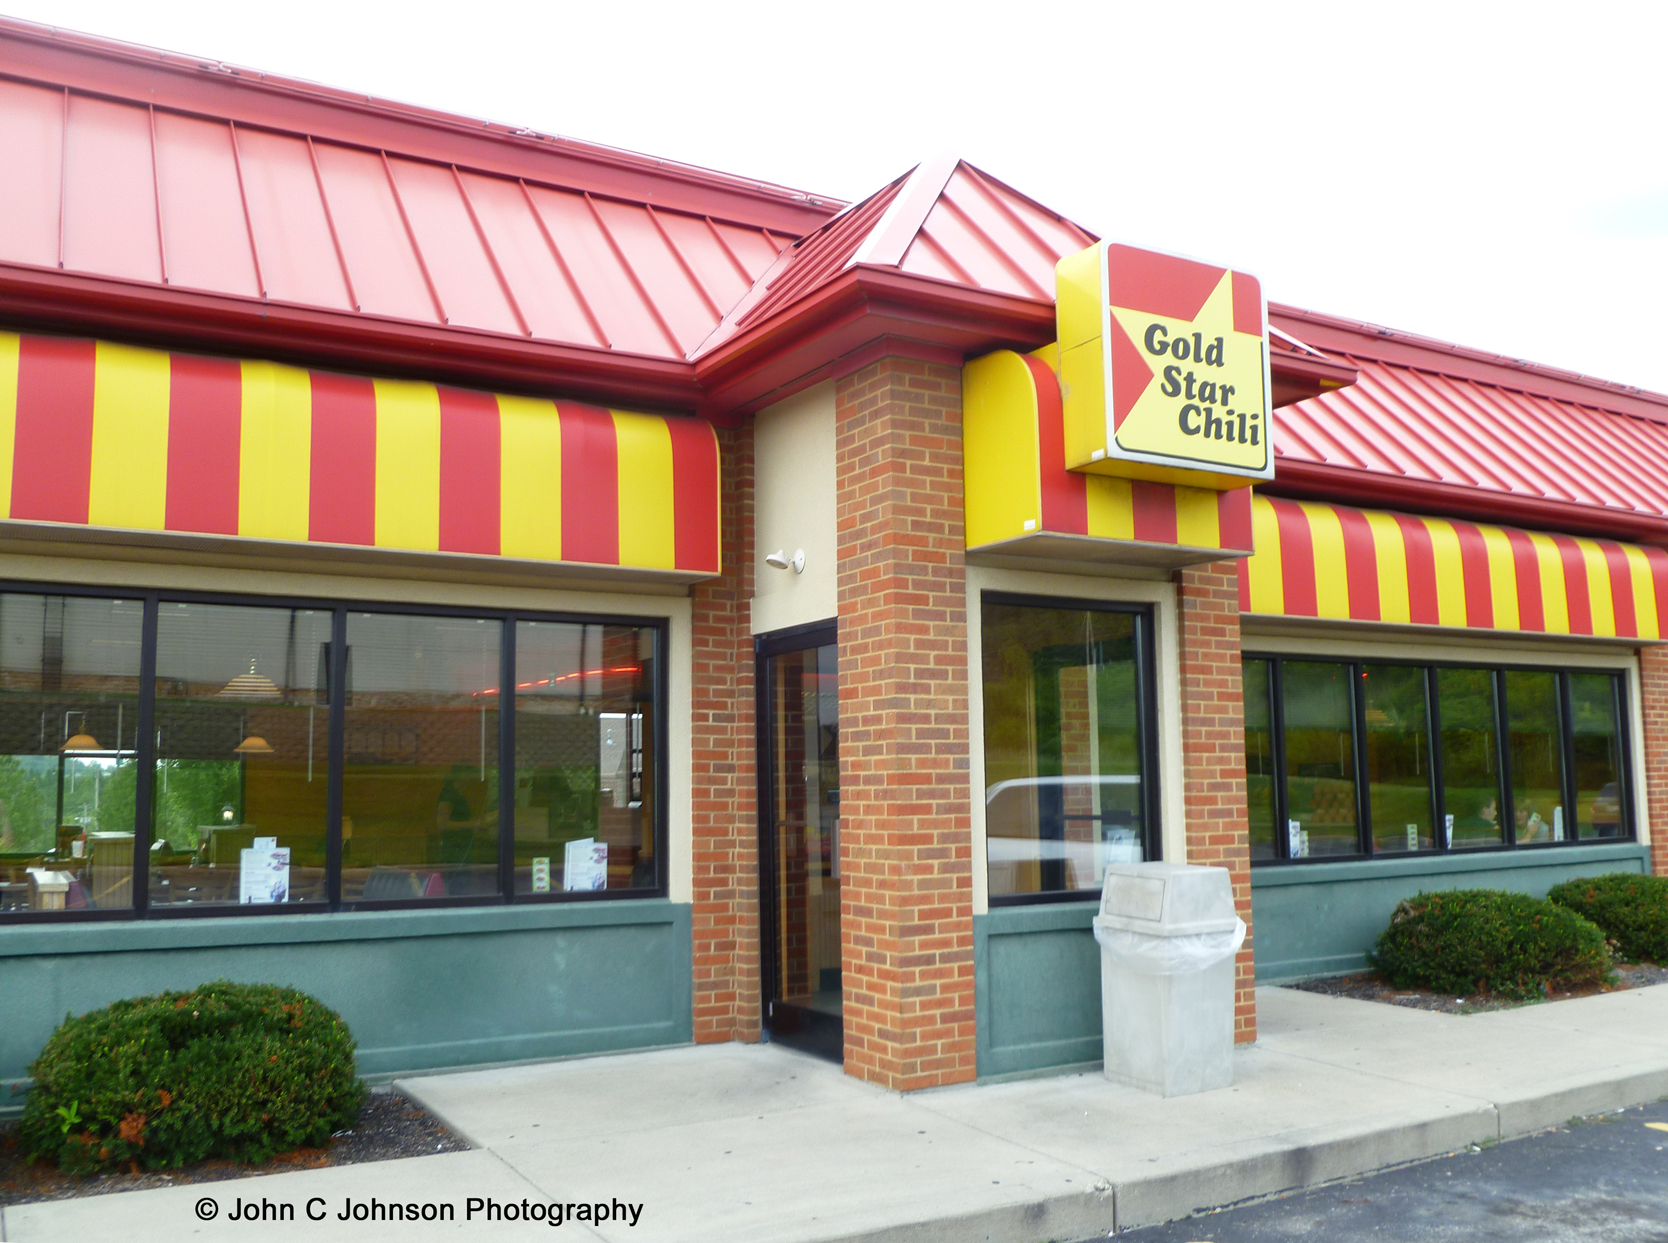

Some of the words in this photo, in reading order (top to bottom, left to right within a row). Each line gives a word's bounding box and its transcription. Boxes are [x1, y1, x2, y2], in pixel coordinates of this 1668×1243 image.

[1144, 323, 1225, 368] Gold
[1160, 365, 1236, 407] Star
[1178, 403, 1260, 446] Chili
